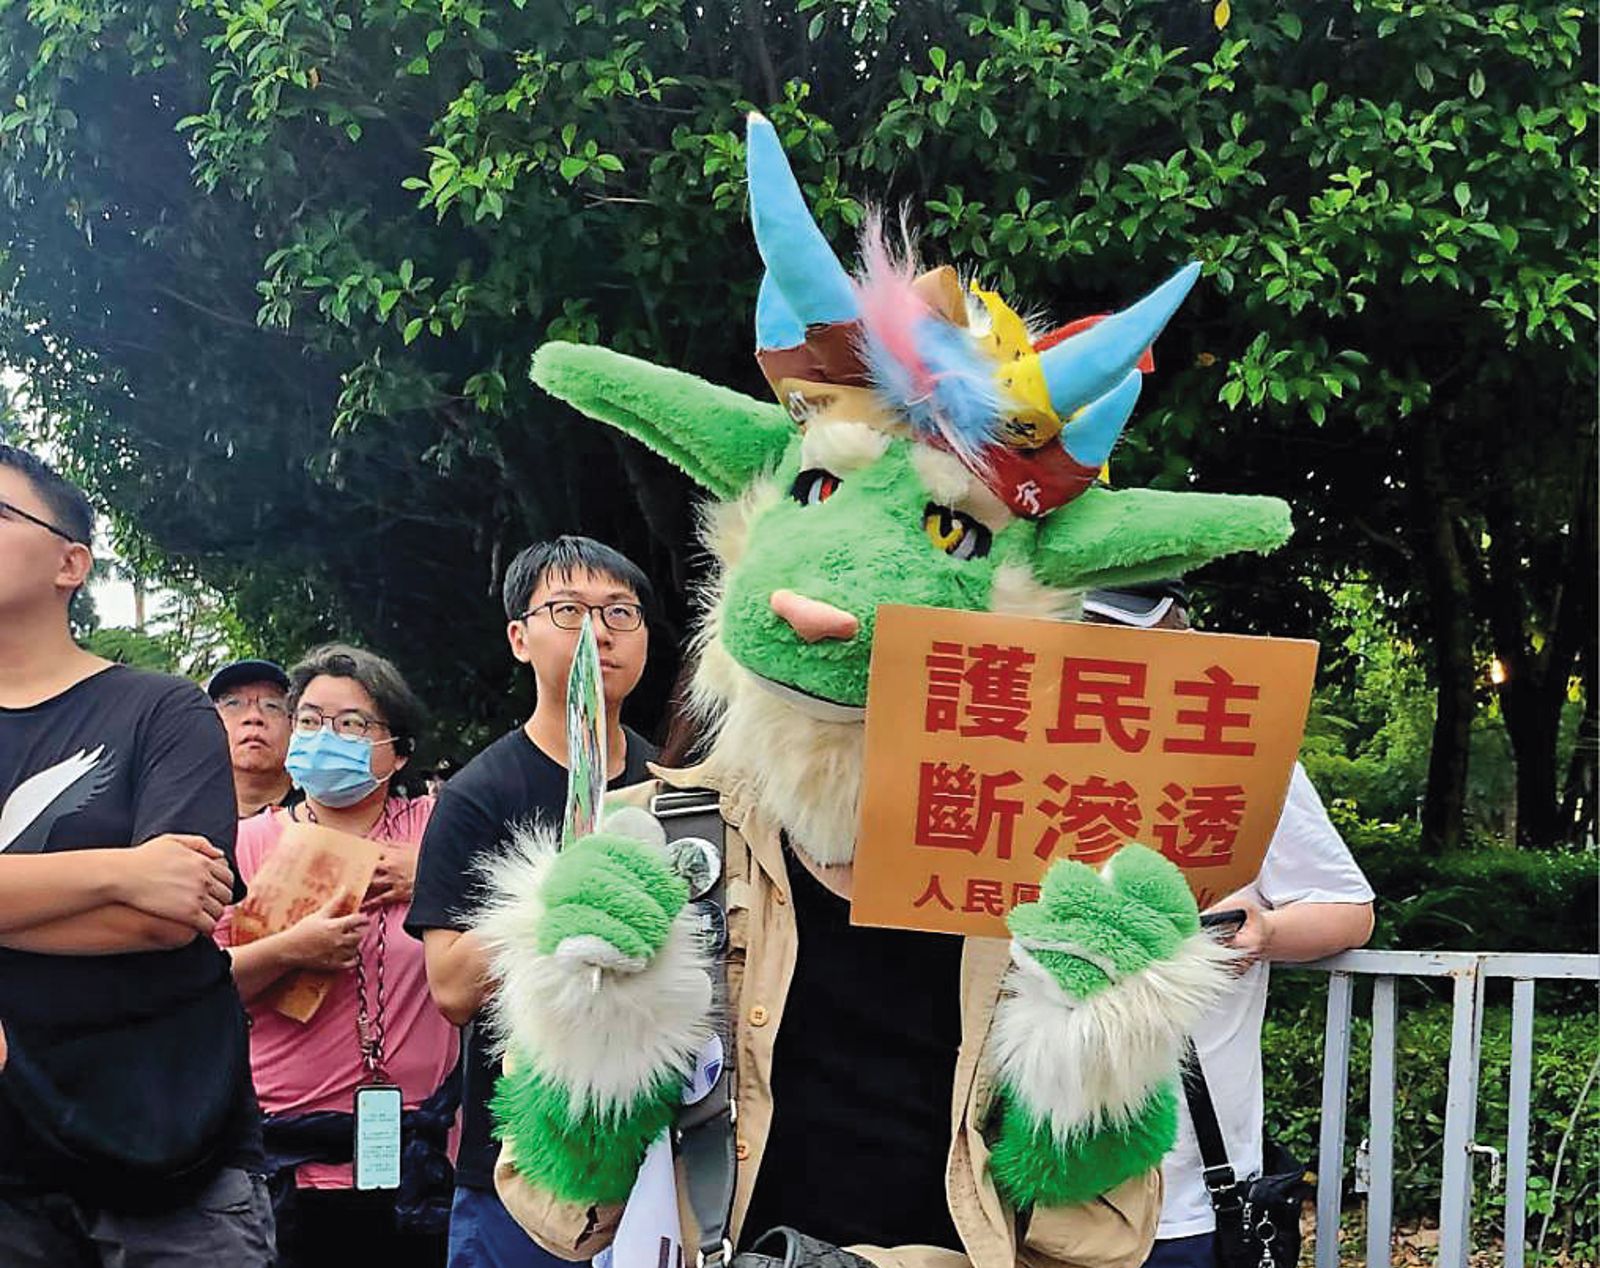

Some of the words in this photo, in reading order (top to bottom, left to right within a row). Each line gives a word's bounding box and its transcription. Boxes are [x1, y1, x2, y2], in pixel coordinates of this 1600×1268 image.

[925, 640, 1261, 757] 護民主
[914, 761, 1247, 869] 斷滲透
